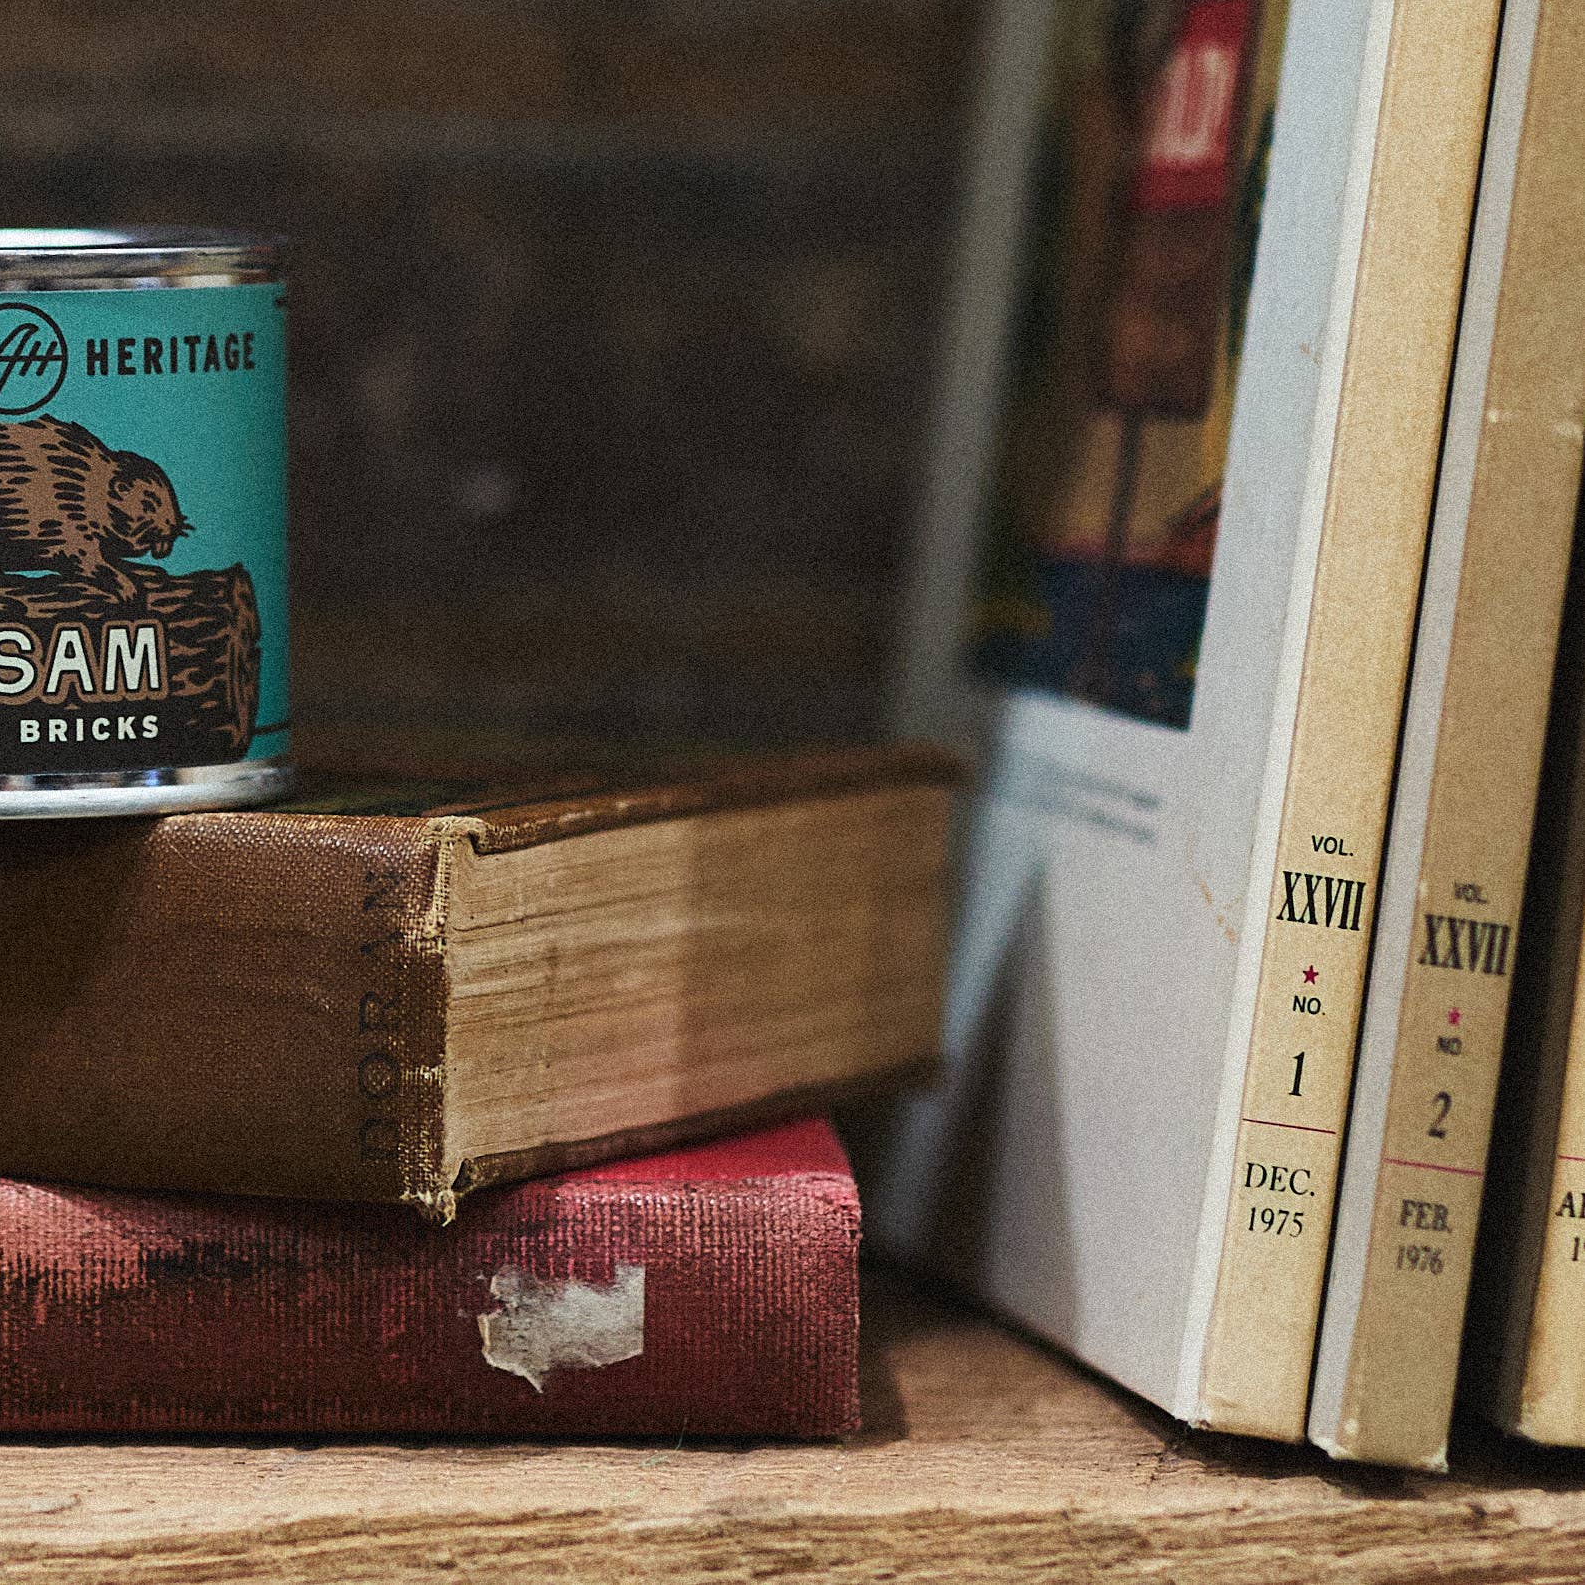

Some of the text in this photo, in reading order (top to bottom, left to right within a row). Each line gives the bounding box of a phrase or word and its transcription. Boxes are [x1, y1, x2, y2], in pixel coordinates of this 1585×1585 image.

[86, 332, 256, 376] HERITAGE
[19, 715, 159, 743] BRICKS
[1310, 834, 1354, 857] VOL.
[1276, 870, 1366, 931] XXVII
[1417, 913, 1511, 977] XXVII
[1292, 994, 1326, 1016] NO.
[1288, 1051, 1306, 1097] 1
[1428, 1091, 1453, 1139] 2
[1244, 1162, 1315, 1197] DEC.
[1248, 1206, 1304, 1238] 1975
[1400, 1199, 1452, 1233] FEB.
[1396, 1245, 1445, 1275] 1976
